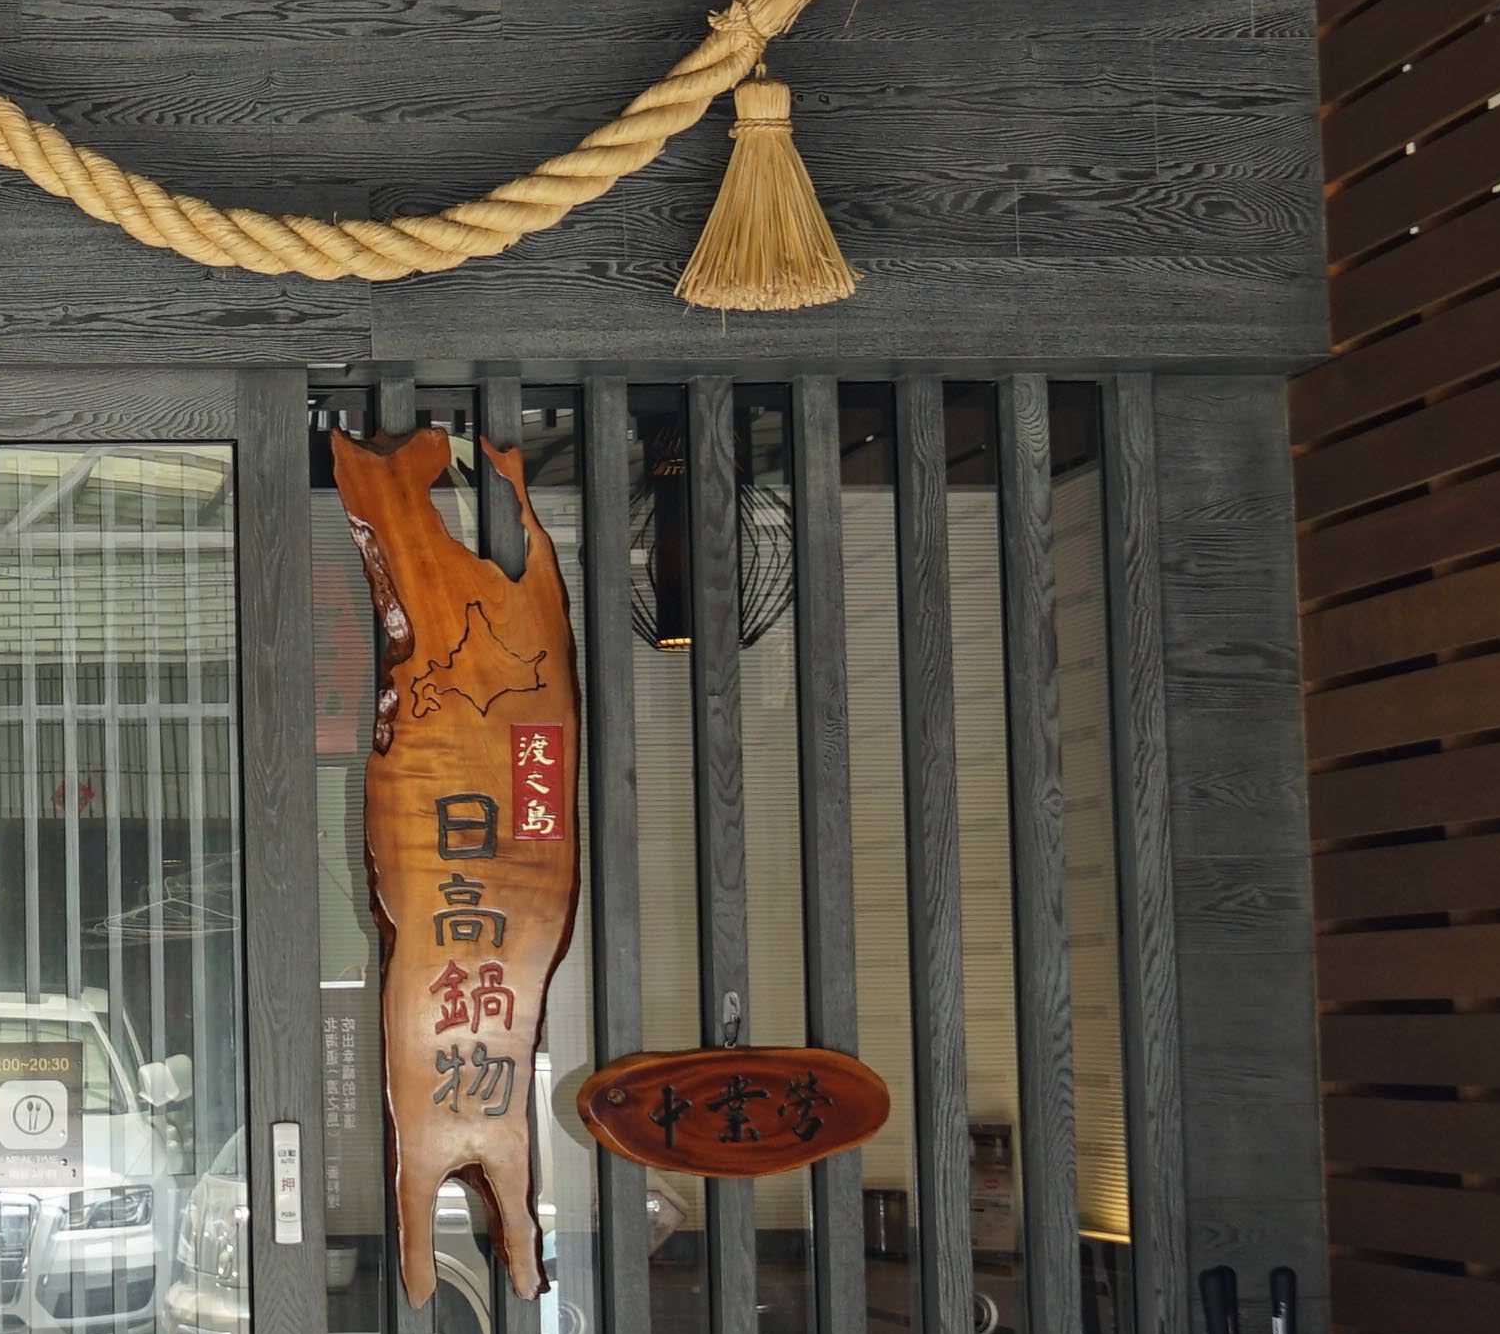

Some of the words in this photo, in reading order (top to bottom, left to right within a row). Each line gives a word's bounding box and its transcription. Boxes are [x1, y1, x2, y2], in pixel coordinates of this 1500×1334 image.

[518, 732, 557, 835] 渡之島
[429, 791, 516, 1117] 日高鍋物
